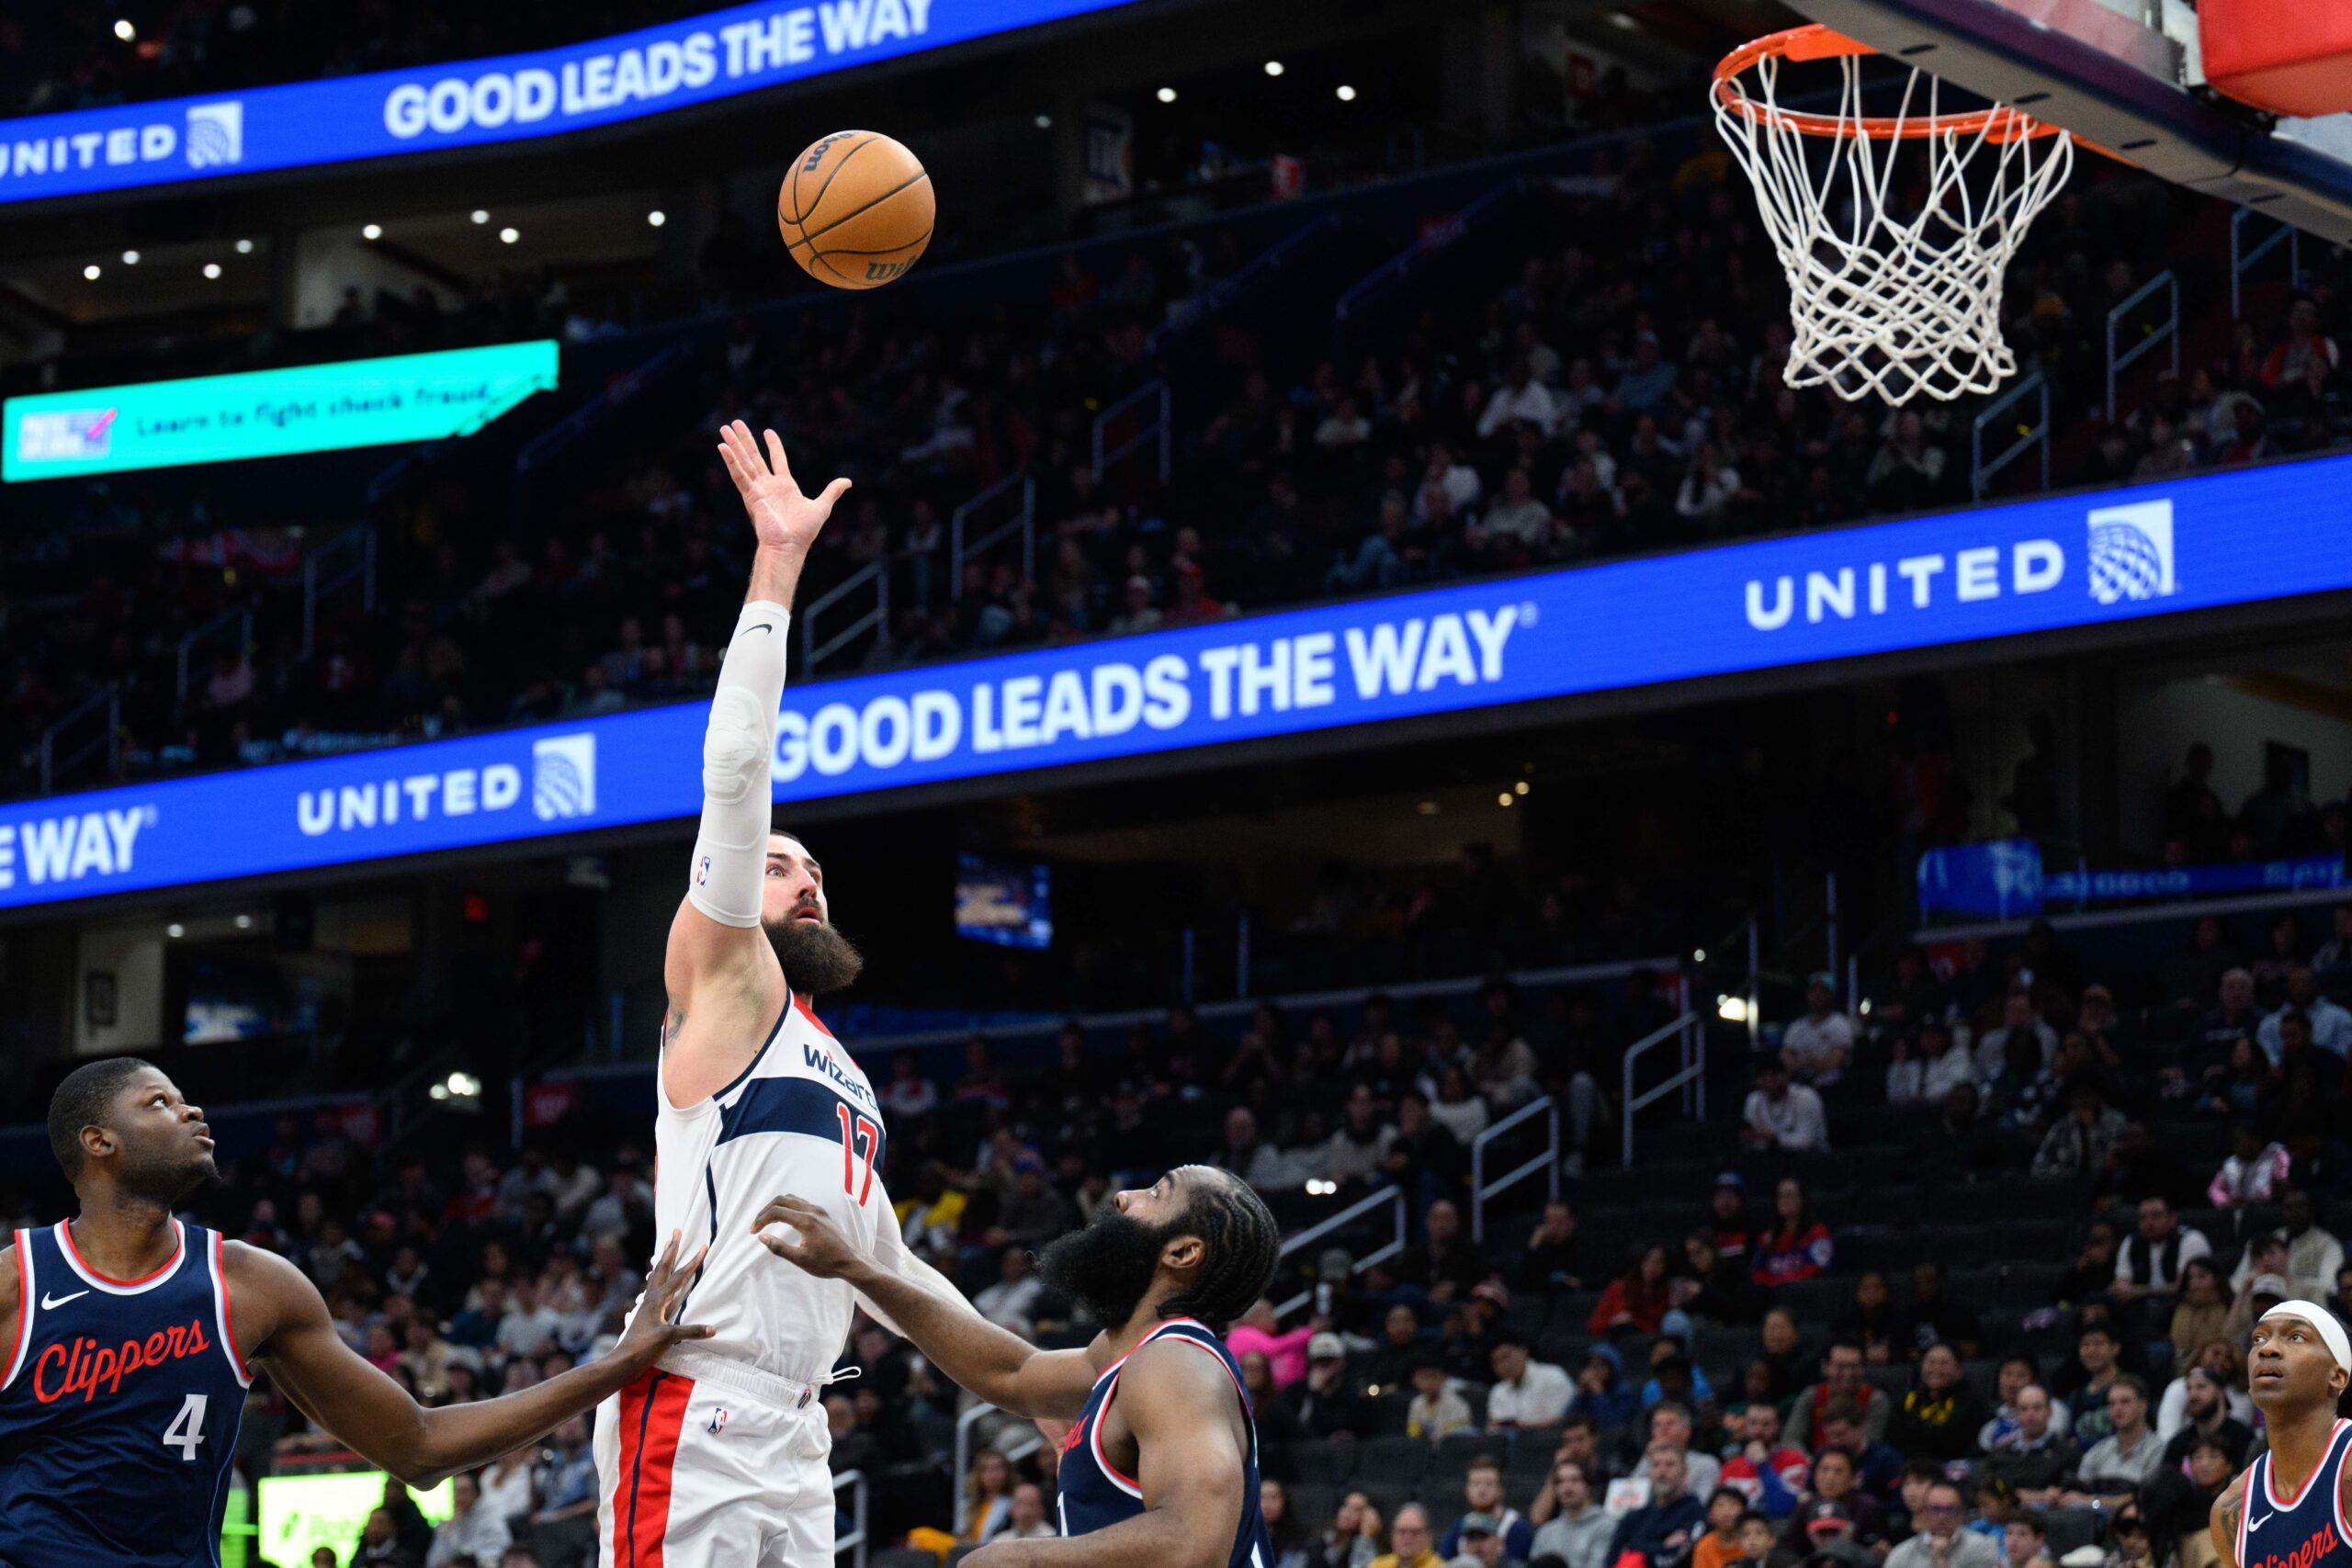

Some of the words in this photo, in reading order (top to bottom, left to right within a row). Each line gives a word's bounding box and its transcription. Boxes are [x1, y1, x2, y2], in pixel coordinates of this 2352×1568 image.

[383, 68, 559, 139] GOOD
[561, 31, 718, 116] LEADS
[719, 6, 816, 79] THE
[819, 0, 933, 54] WAY
[0, 123, 178, 179] NITED
[1746, 538, 2065, 631] UNITED
[770, 689, 963, 783] GOOD
[972, 653, 1192, 754] LEADS
[1200, 631, 1336, 721] THE
[297, 763, 522, 838] UNITED
[837, 1101, 879, 1210] 17
[33, 1318, 210, 1404] Clippers
[163, 1393, 209, 1461] 4
